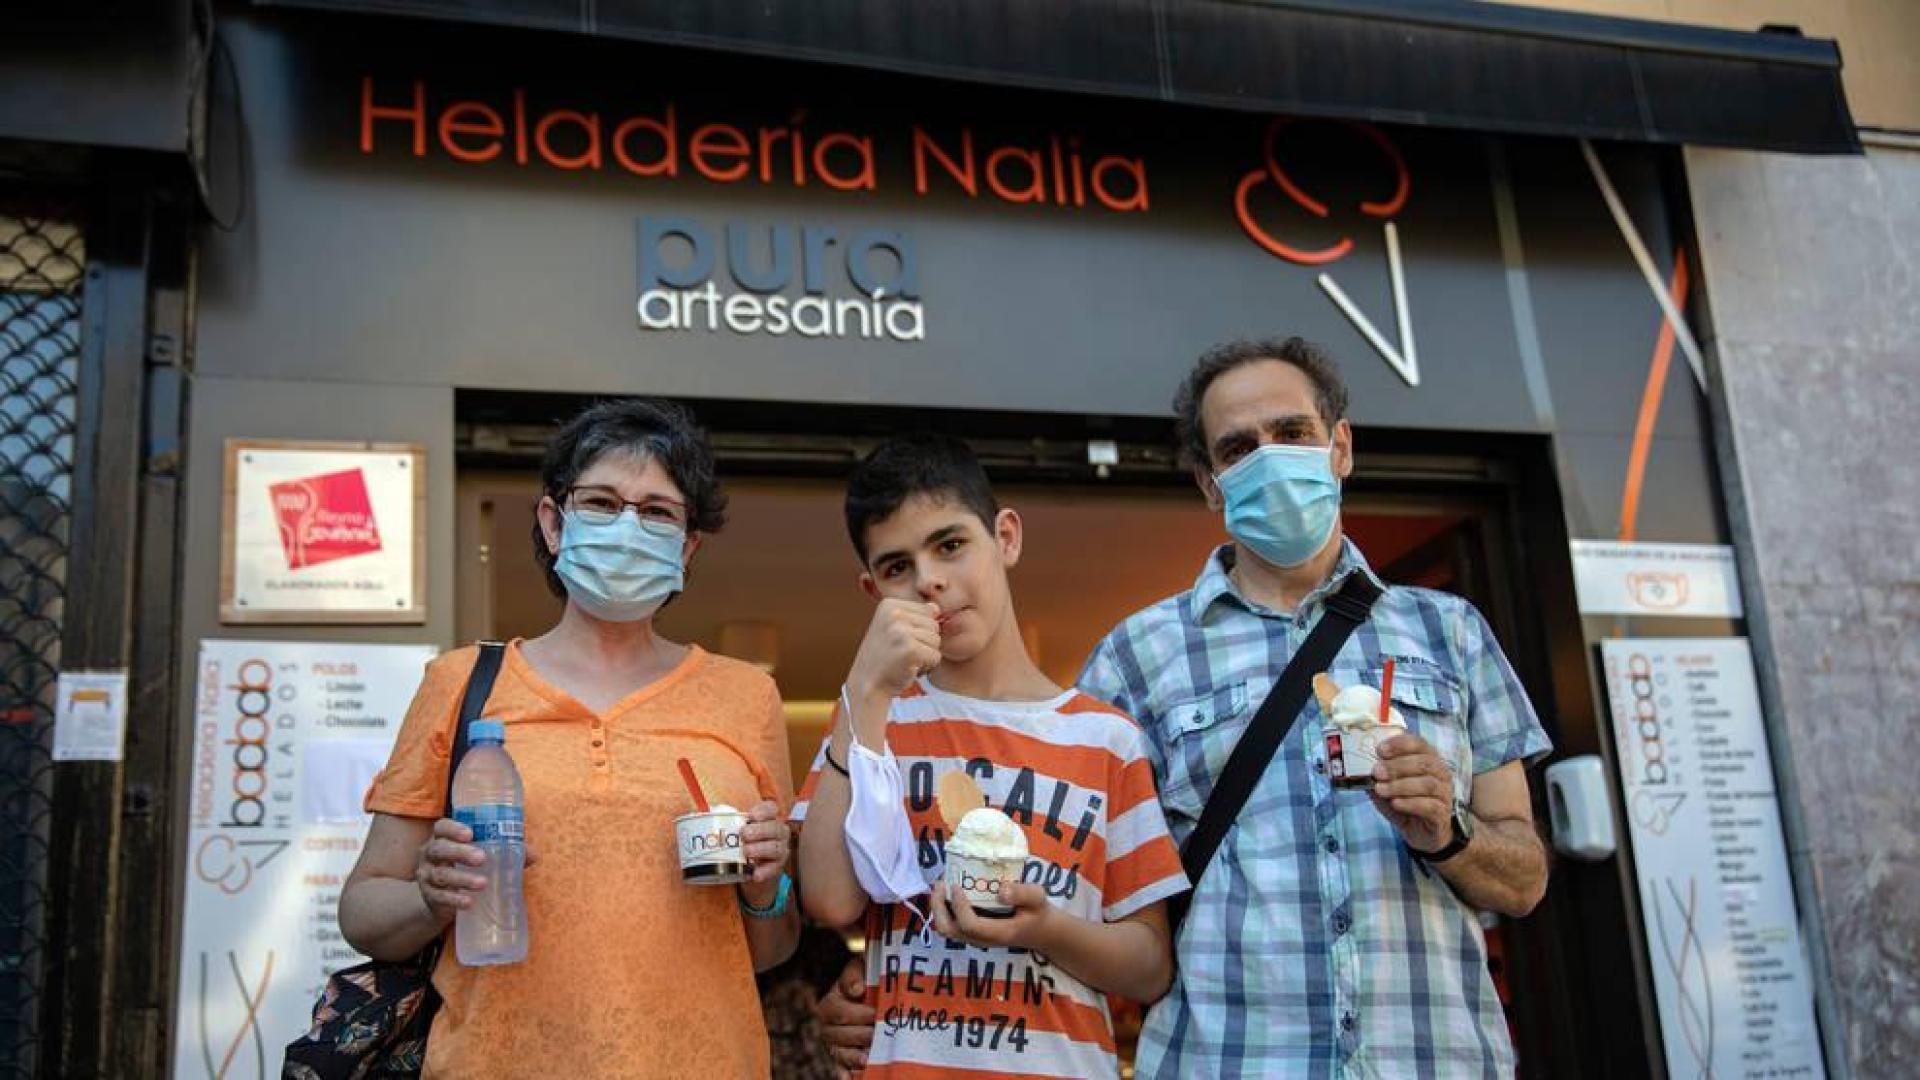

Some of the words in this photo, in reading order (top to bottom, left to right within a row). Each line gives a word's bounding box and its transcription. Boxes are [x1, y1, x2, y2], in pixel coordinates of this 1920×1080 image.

[359, 76, 876, 192] Heladería
[913, 126, 1151, 213] Nalia
[635, 214, 920, 298] pura
[637, 281, 926, 341] artesanía
[953, 1013, 1029, 1054] 1974
